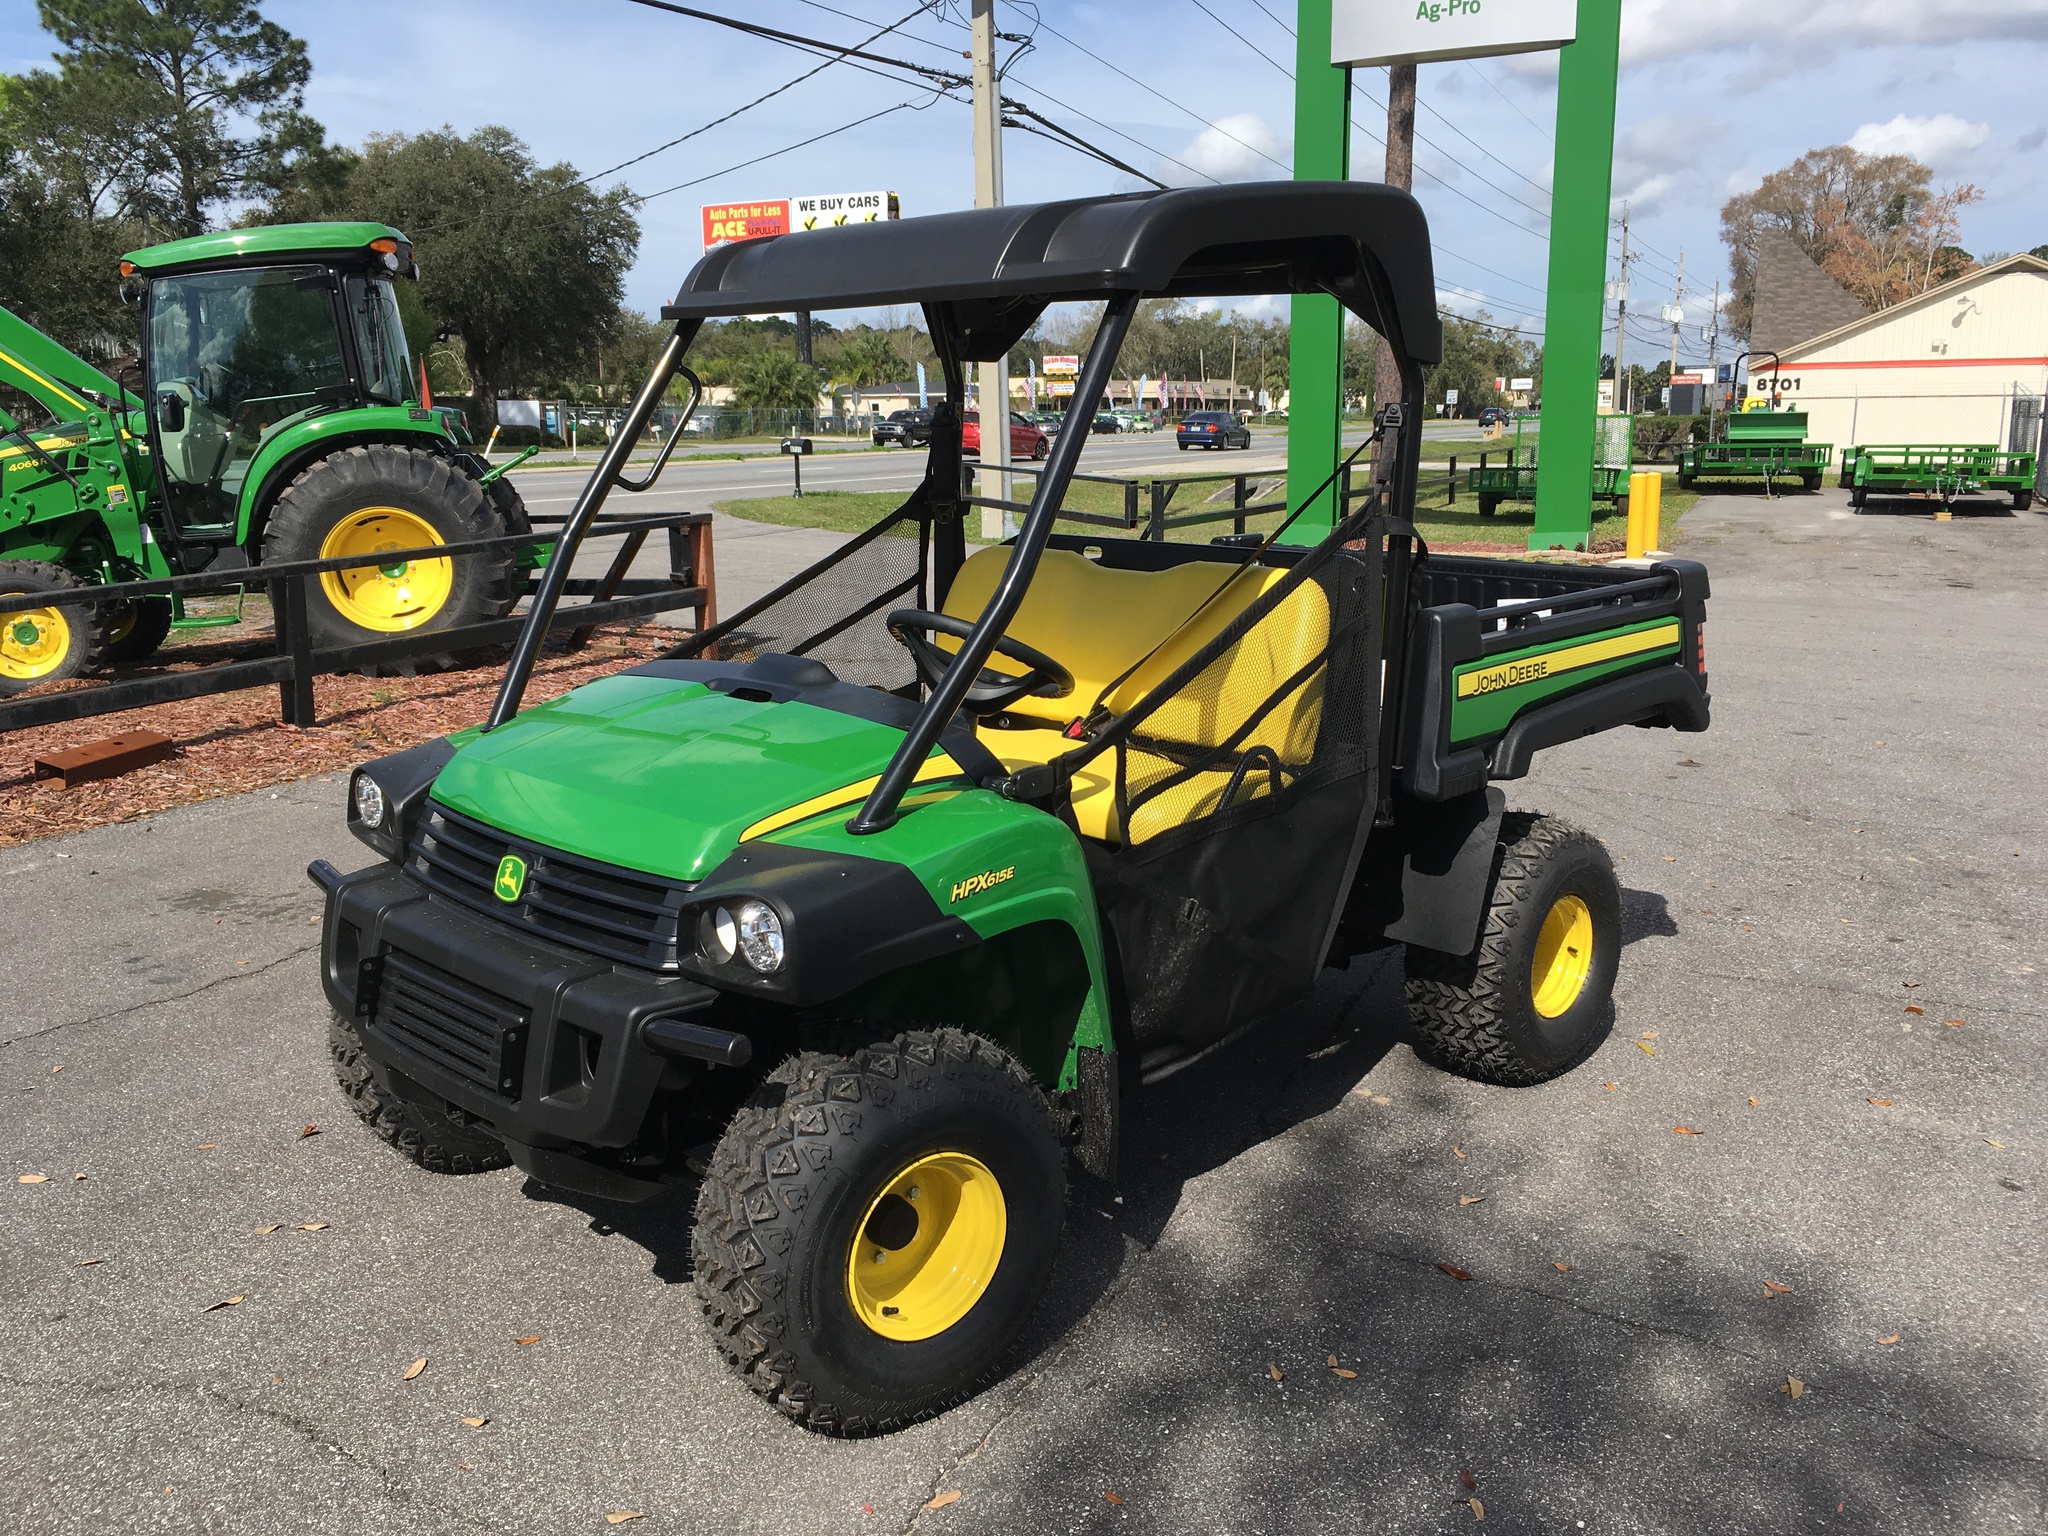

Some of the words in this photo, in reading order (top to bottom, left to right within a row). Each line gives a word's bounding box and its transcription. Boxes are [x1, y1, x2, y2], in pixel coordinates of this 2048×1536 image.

[1416, 0, 1481, 22] Ag-Pro
[799, 200, 816, 212] WE
[820, 198, 844, 211] BUY
[847, 195, 880, 209] CARS
[709, 208, 727, 221] Auto
[728, 206, 749, 219] Parts
[750, 206, 762, 218] for
[763, 204, 781, 217] Less
[711, 220, 747, 238] ACE
[748, 226, 781, 236] U-PULL-IT
[1757, 378, 1801, 391] 8701
[59, 437, 87, 448] JOHN
[1473, 671, 1507, 693] JOHN
[1509, 661, 1548, 684] DEERE
[950, 865, 1015, 904] HPX615E
